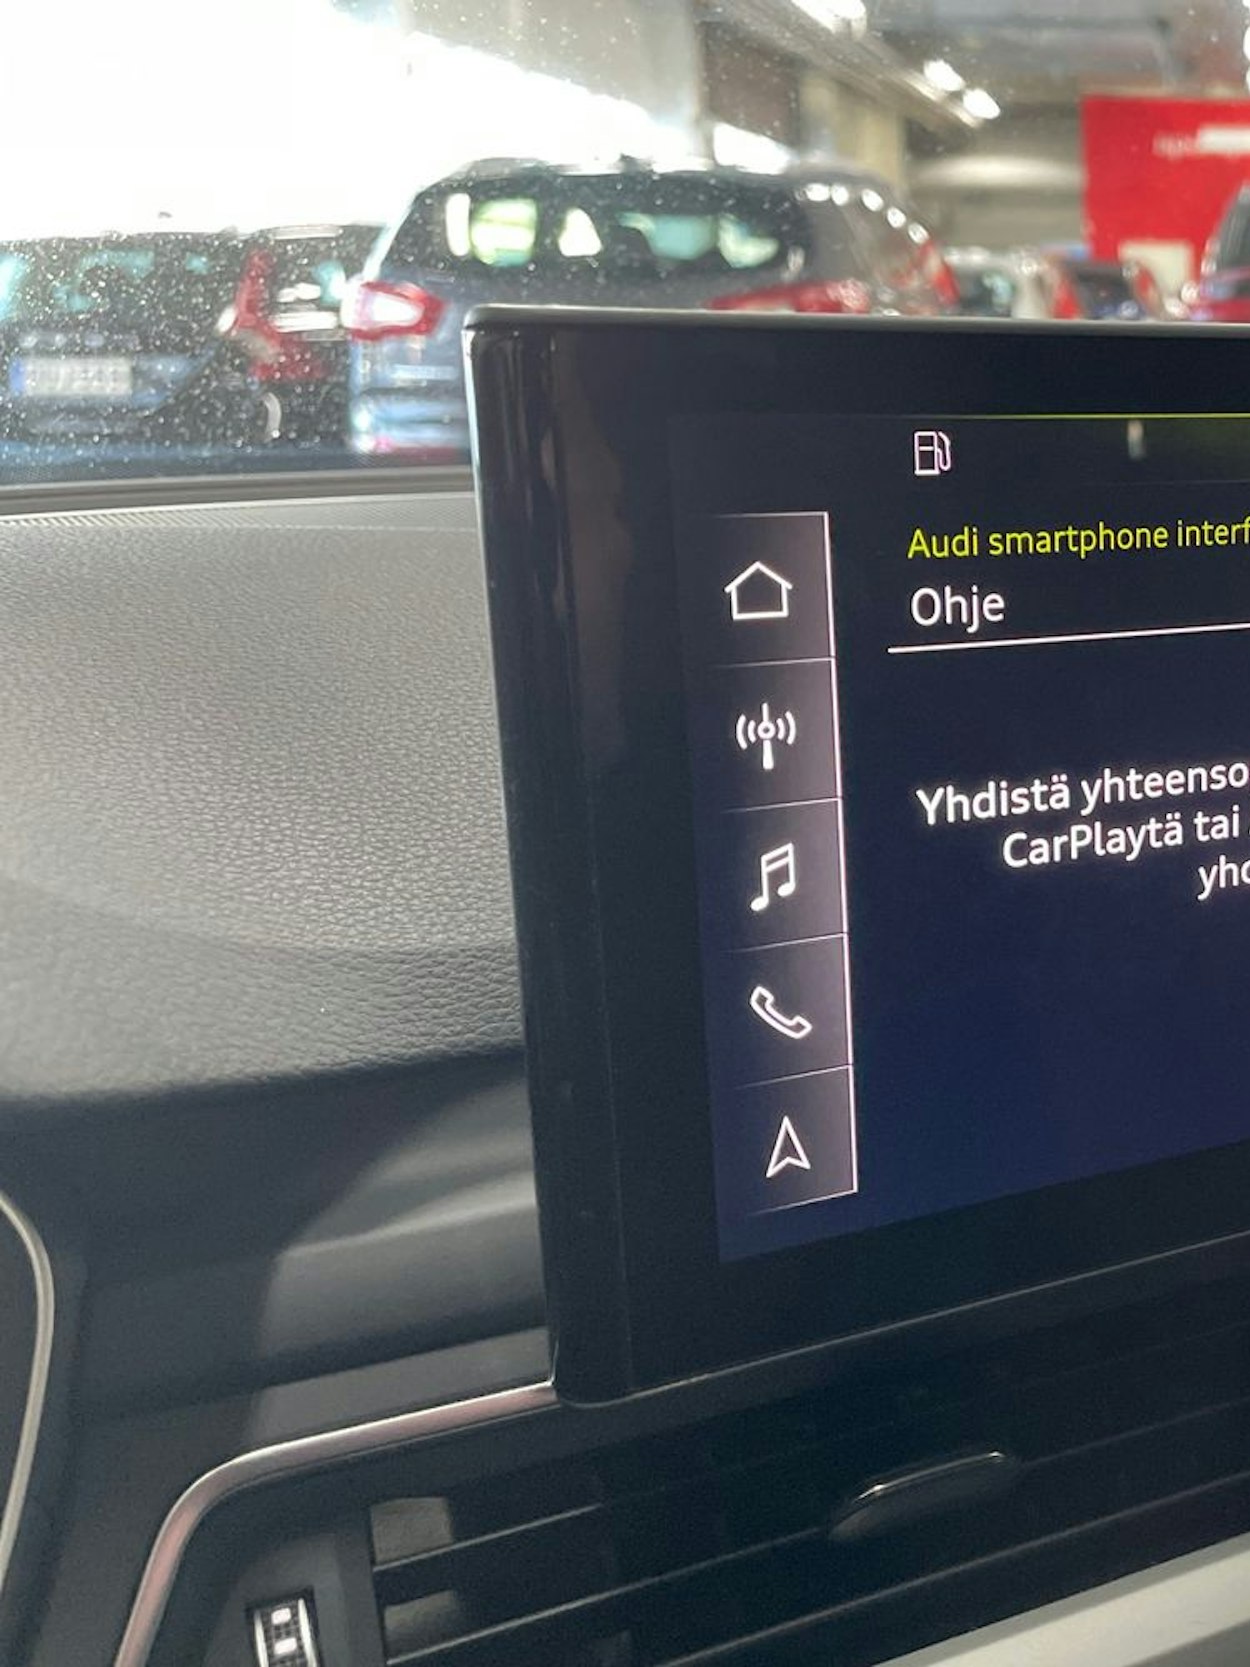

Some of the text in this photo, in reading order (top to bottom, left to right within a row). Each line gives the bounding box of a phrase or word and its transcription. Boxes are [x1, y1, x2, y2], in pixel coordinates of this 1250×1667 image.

[907, 525, 980, 559] Audi
[988, 520, 1168, 559] smartphone
[910, 585, 1006, 633] Ohje
[916, 774, 1071, 826] Yhdistä
[1002, 814, 1184, 868] CarPlaytä
[1194, 805, 1240, 842] tai
